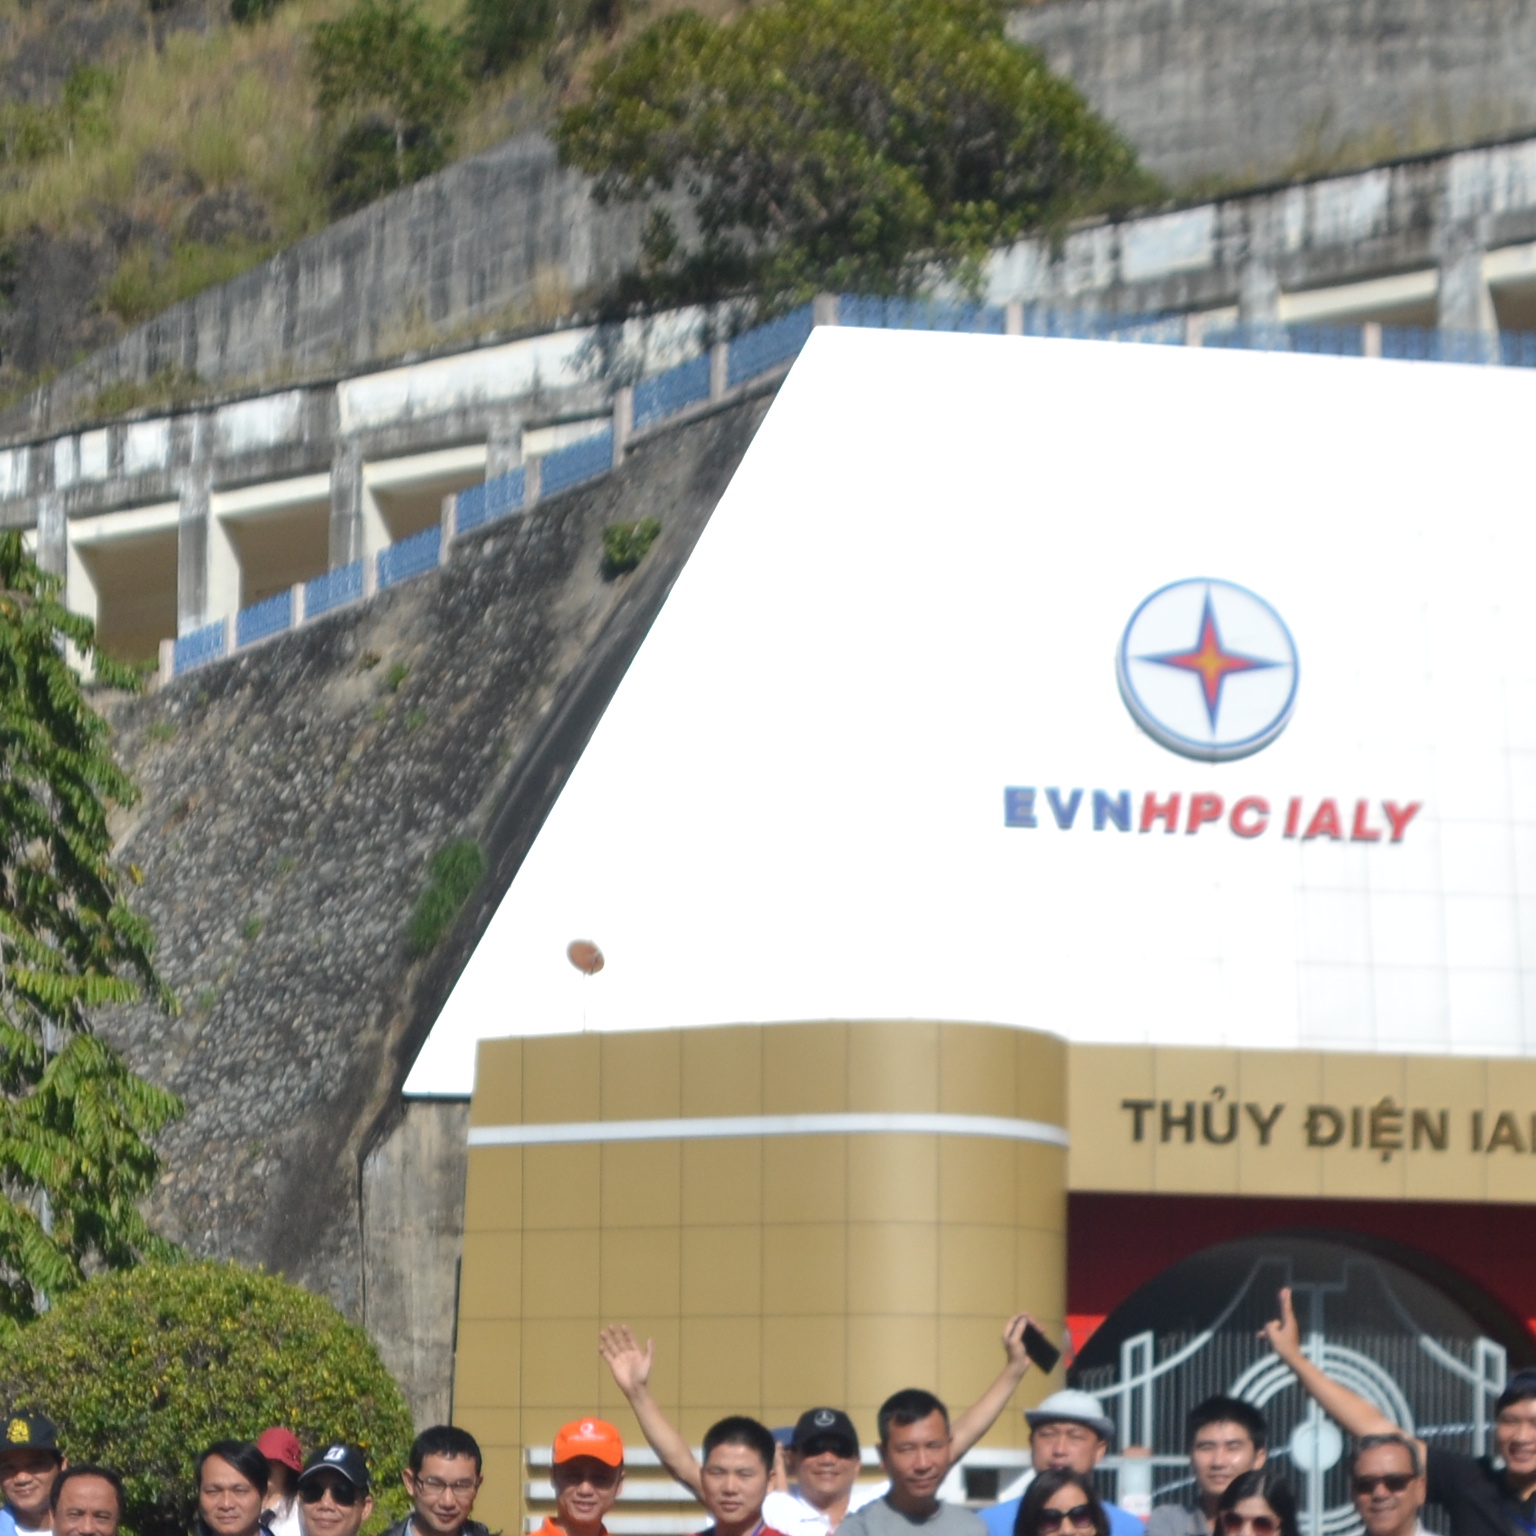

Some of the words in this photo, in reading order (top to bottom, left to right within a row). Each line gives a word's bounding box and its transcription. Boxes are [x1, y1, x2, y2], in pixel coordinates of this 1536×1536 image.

[1281, 796, 1423, 844] IALY
[1121, 1085, 1285, 1147] THỦY
[1305, 1096, 1451, 1163] ĐIỆN
